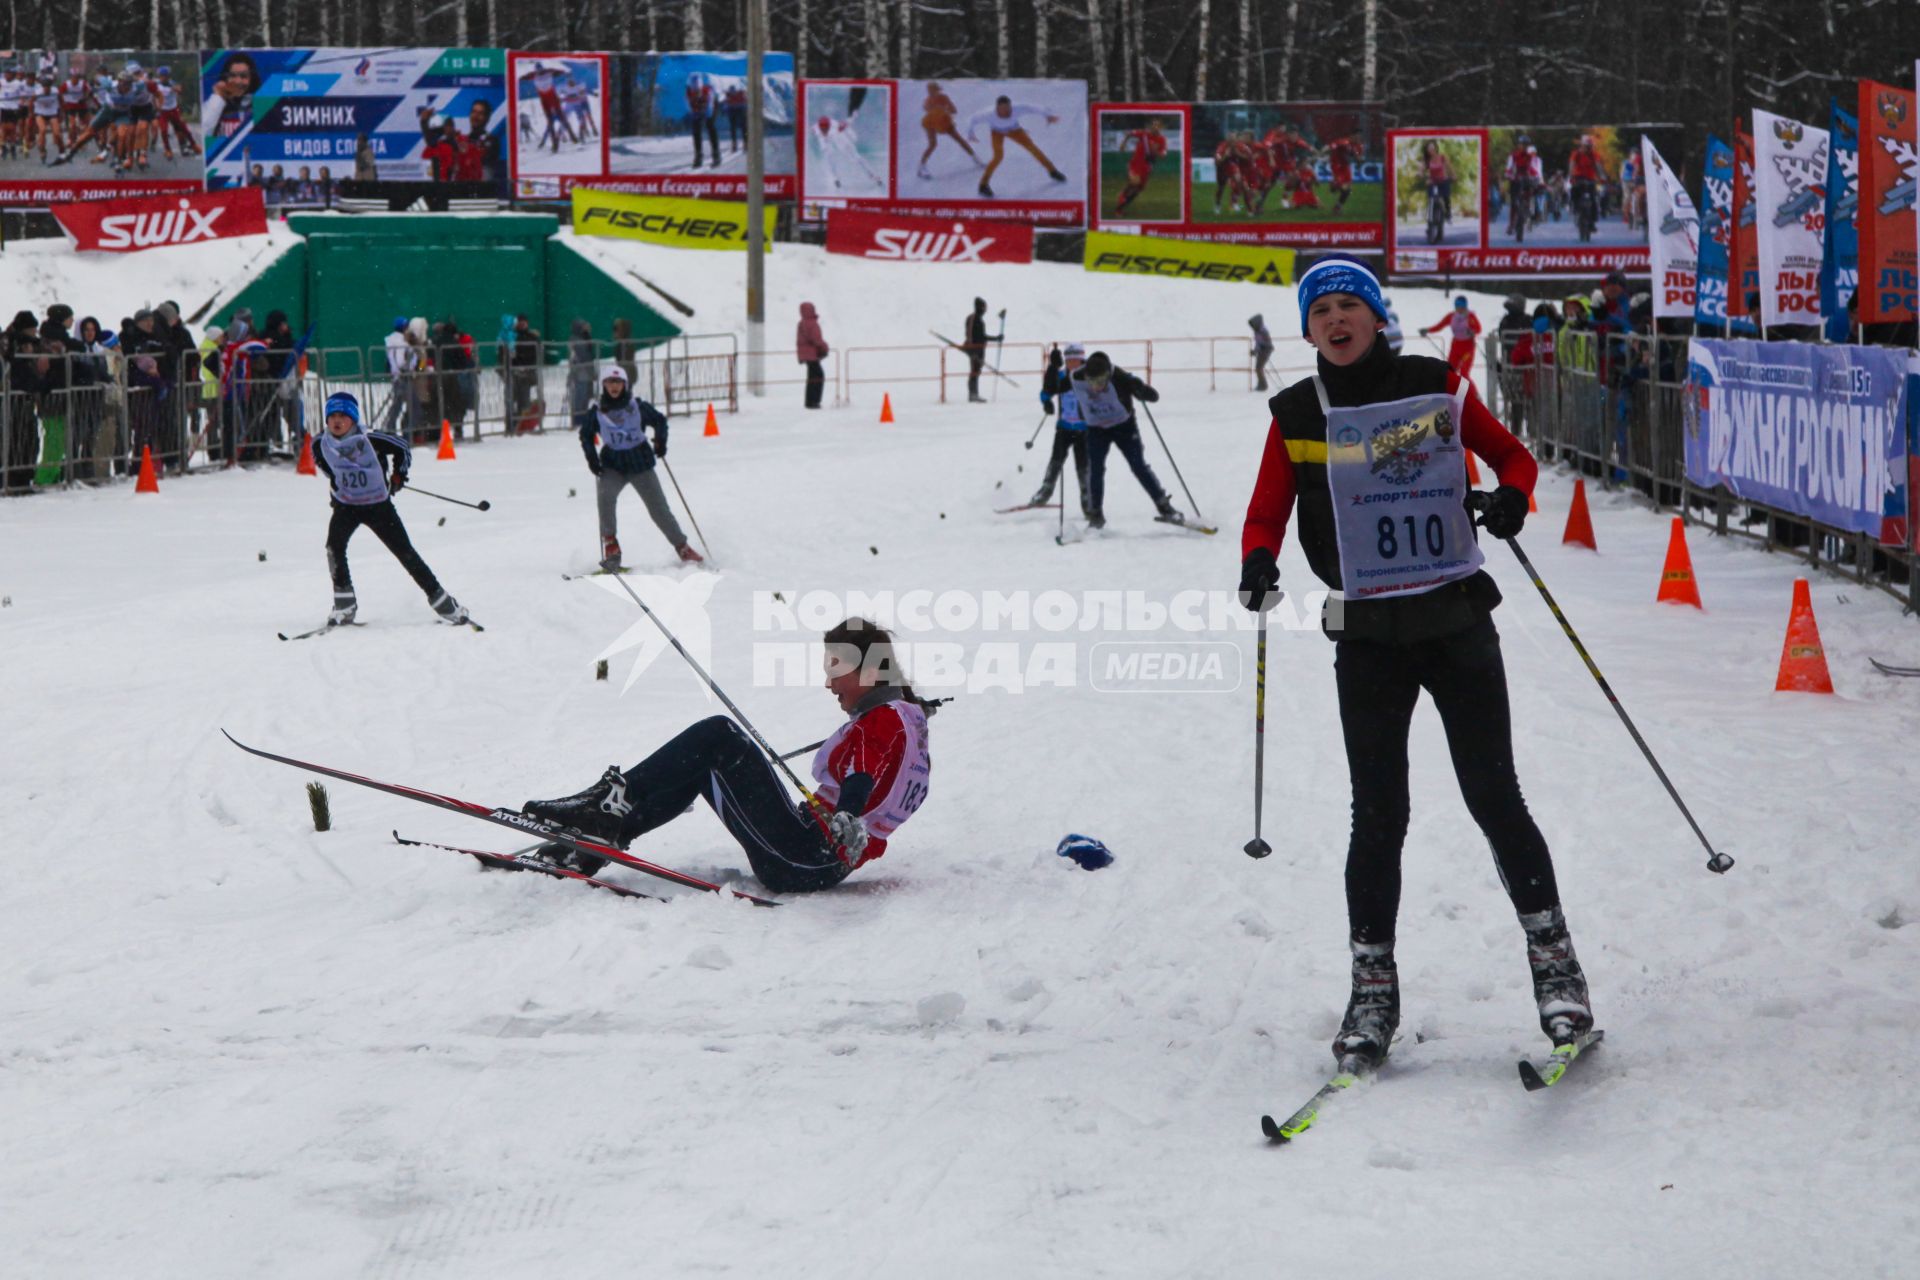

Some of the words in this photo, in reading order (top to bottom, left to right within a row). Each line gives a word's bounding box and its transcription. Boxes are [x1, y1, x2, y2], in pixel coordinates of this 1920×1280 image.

[281, 79, 310, 93] ДЕНЬ
[282, 105, 356, 127] ЗИМНИХ
[283, 138, 331, 157] ВИДОВ
[335, 138, 388, 155] СПТА
[581, 206, 739, 241] FISCHER
[1093, 251, 1255, 283] FISCHER
[1452, 251, 1480, 269] Ты
[1516, 250, 1597, 271] верном
[1316, 283, 1355, 295] 2015
[1372, 418, 1420, 437] ЛЫЖНЯ
[1380, 469, 1424, 485] РОССИИ
[1377, 513, 1445, 560] 810
[1356, 564, 1431, 579] Воронежская
[898, 779, 928, 814] 183
[490, 810, 552, 834] ATOMIC
